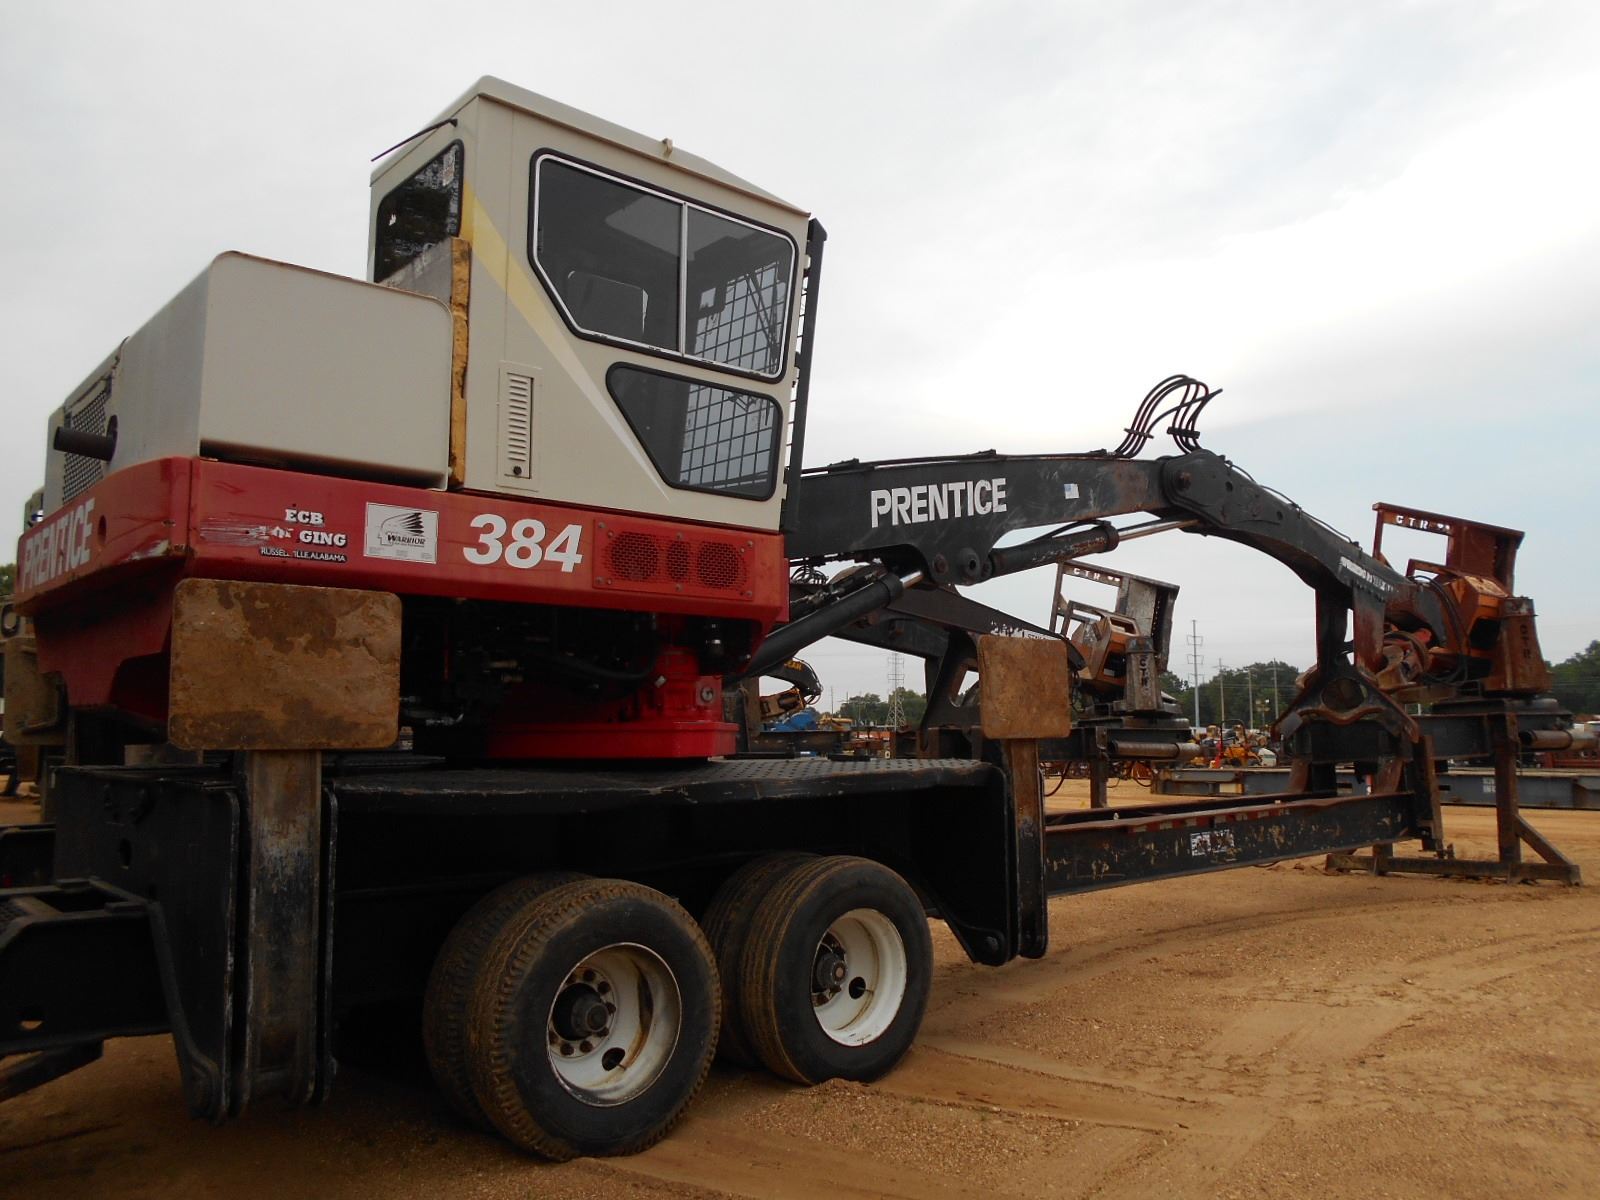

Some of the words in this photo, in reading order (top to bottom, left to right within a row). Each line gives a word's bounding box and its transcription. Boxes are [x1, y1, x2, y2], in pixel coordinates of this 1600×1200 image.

[285, 508, 324, 525] ECB
[871, 478, 1007, 528] PRENTICE
[22, 498, 95, 593] PRENTICE
[463, 513, 583, 573] 384
